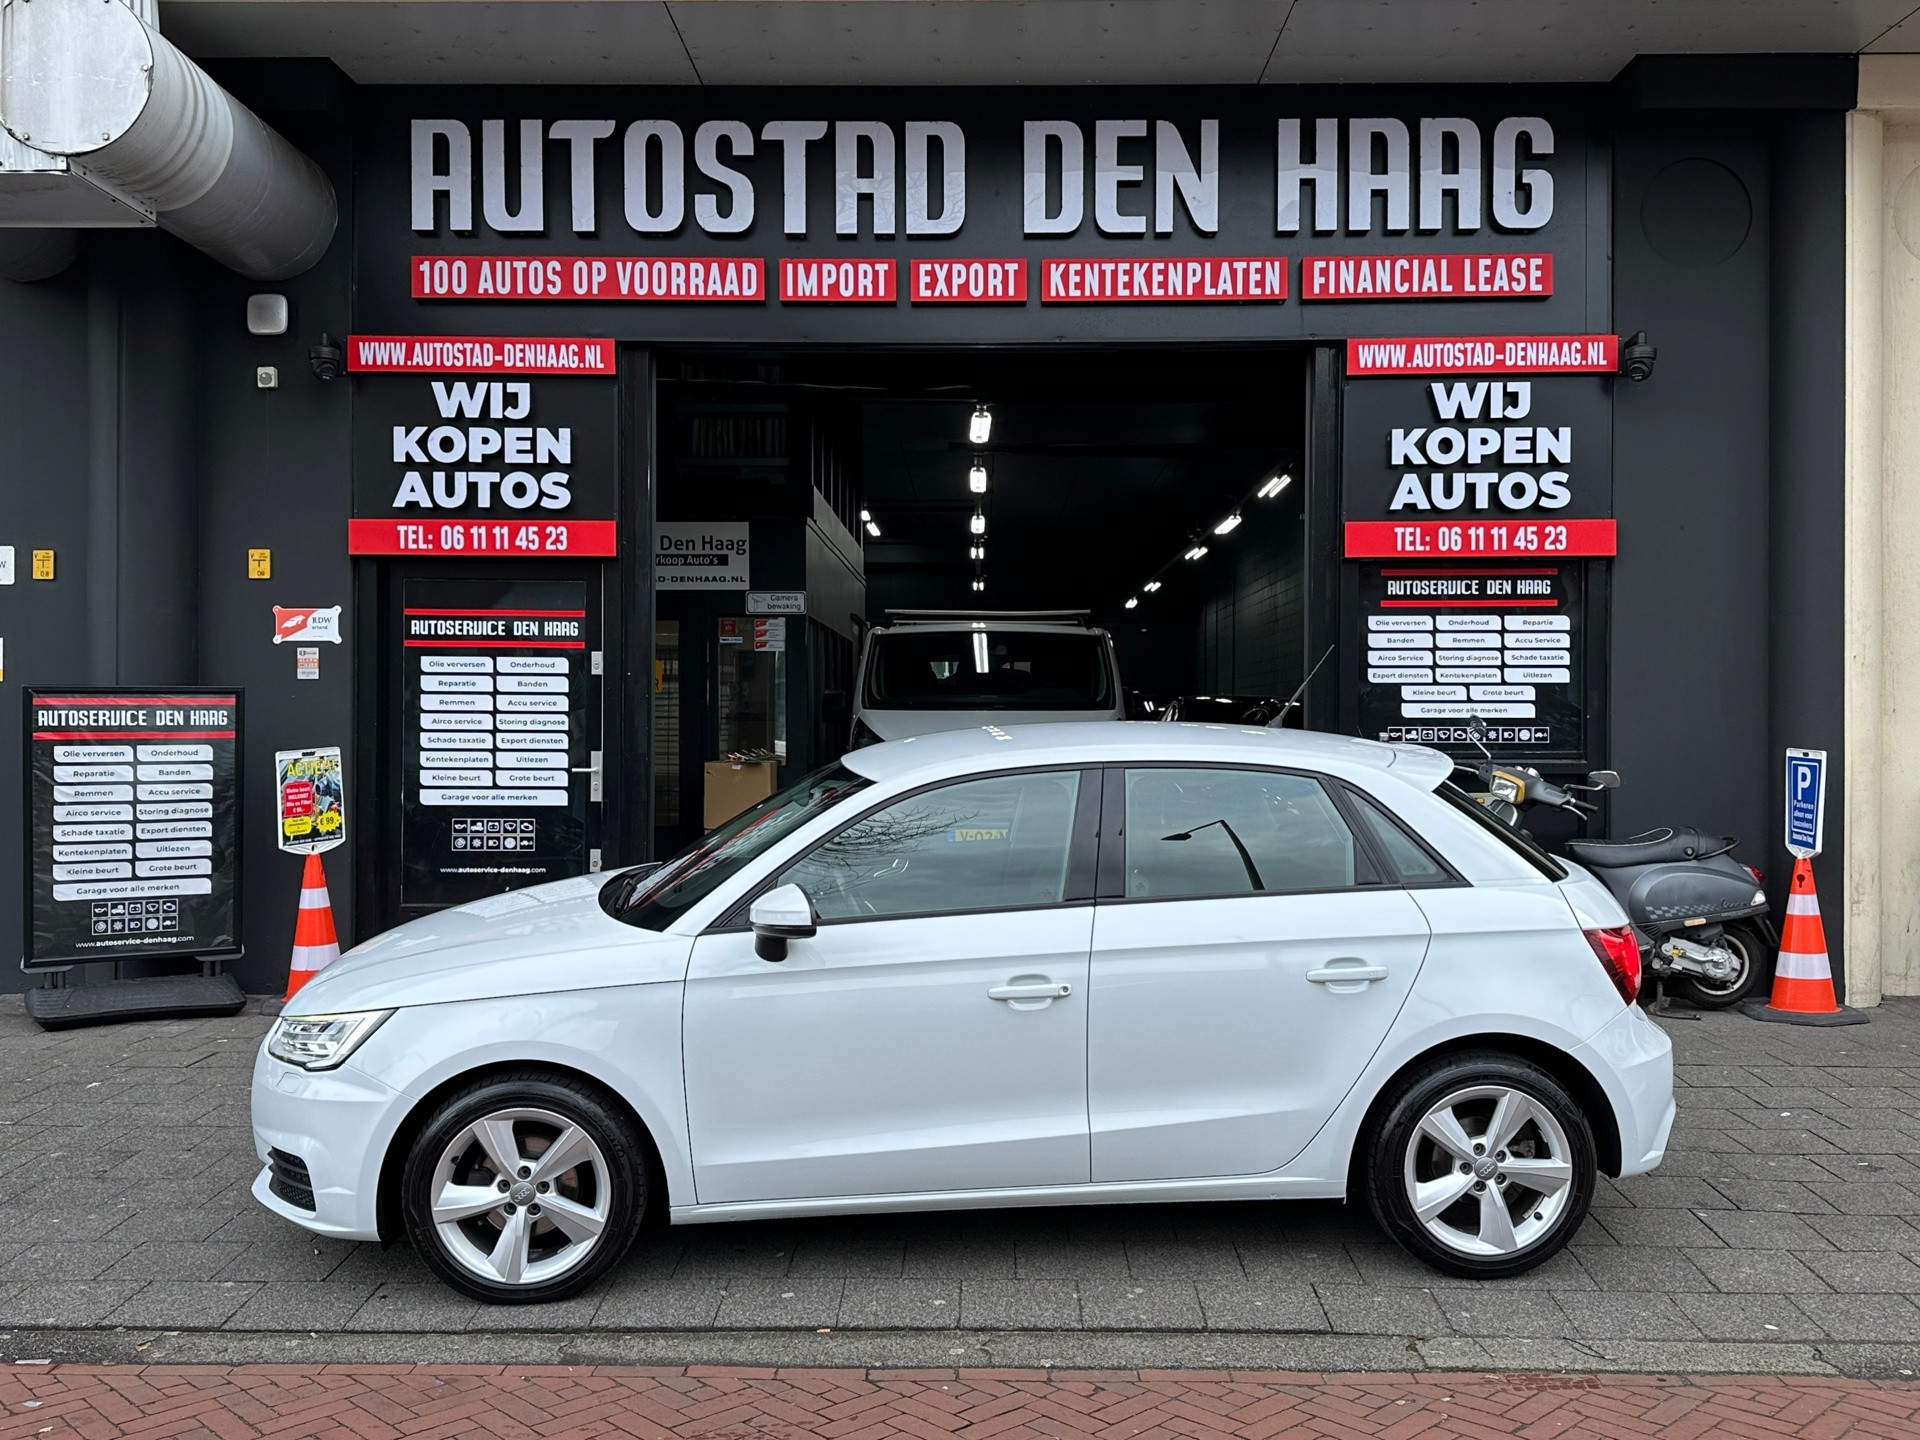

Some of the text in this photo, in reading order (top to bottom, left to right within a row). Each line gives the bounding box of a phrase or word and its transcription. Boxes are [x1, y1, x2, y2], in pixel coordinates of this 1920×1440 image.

[411, 119, 966, 234] AUTOSTAD
[1024, 117, 1554, 234] DEN HAAG
[420, 260, 756, 296] 100 AUTOS OP VOORRAAD
[787, 263, 888, 297] IMPORT
[920, 263, 1018, 297] EXPORT
[1050, 261, 1280, 298] KENTEKENPLATEN
[1314, 258, 1542, 296] FINANCIAL LEASE
[359, 342, 604, 368] WWW.AUTOSTAD-DENHAAG.NL
[1358, 342, 1607, 368] WWW.AUTOSTAD-DENHAAG.NL
[431, 382, 530, 419] WIJ
[1431, 382, 1531, 419] WIJ
[393, 426, 571, 464] KOPEN
[1392, 427, 1571, 464] KOPEN
[392, 472, 571, 509] AUTOS
[1390, 472, 1571, 510] AUTOS
[397, 525, 567, 550] TEL: 06 11 11 45 23
[660, 535, 747, 556] Den Haag
[1394, 526, 1566, 551] TEL: 06 11 11 45 23
[687, 556, 718, 565] Auto's
[1487, 580, 1511, 594] DEN
[1517, 580, 1550, 594] HAAG
[767, 603, 801, 611] bewaking
[514, 621, 538, 636] DEN
[544, 622, 578, 636] HAAG
[156, 710, 184, 726] DEN
[190, 710, 227, 725] HAAG
[1798, 766, 1811, 800] P
[138, 806, 209, 817] Storing diagnose
[58, 848, 127, 856] Kentekenplaten
[76, 936, 194, 948] www.autoservice-denhaag.com
